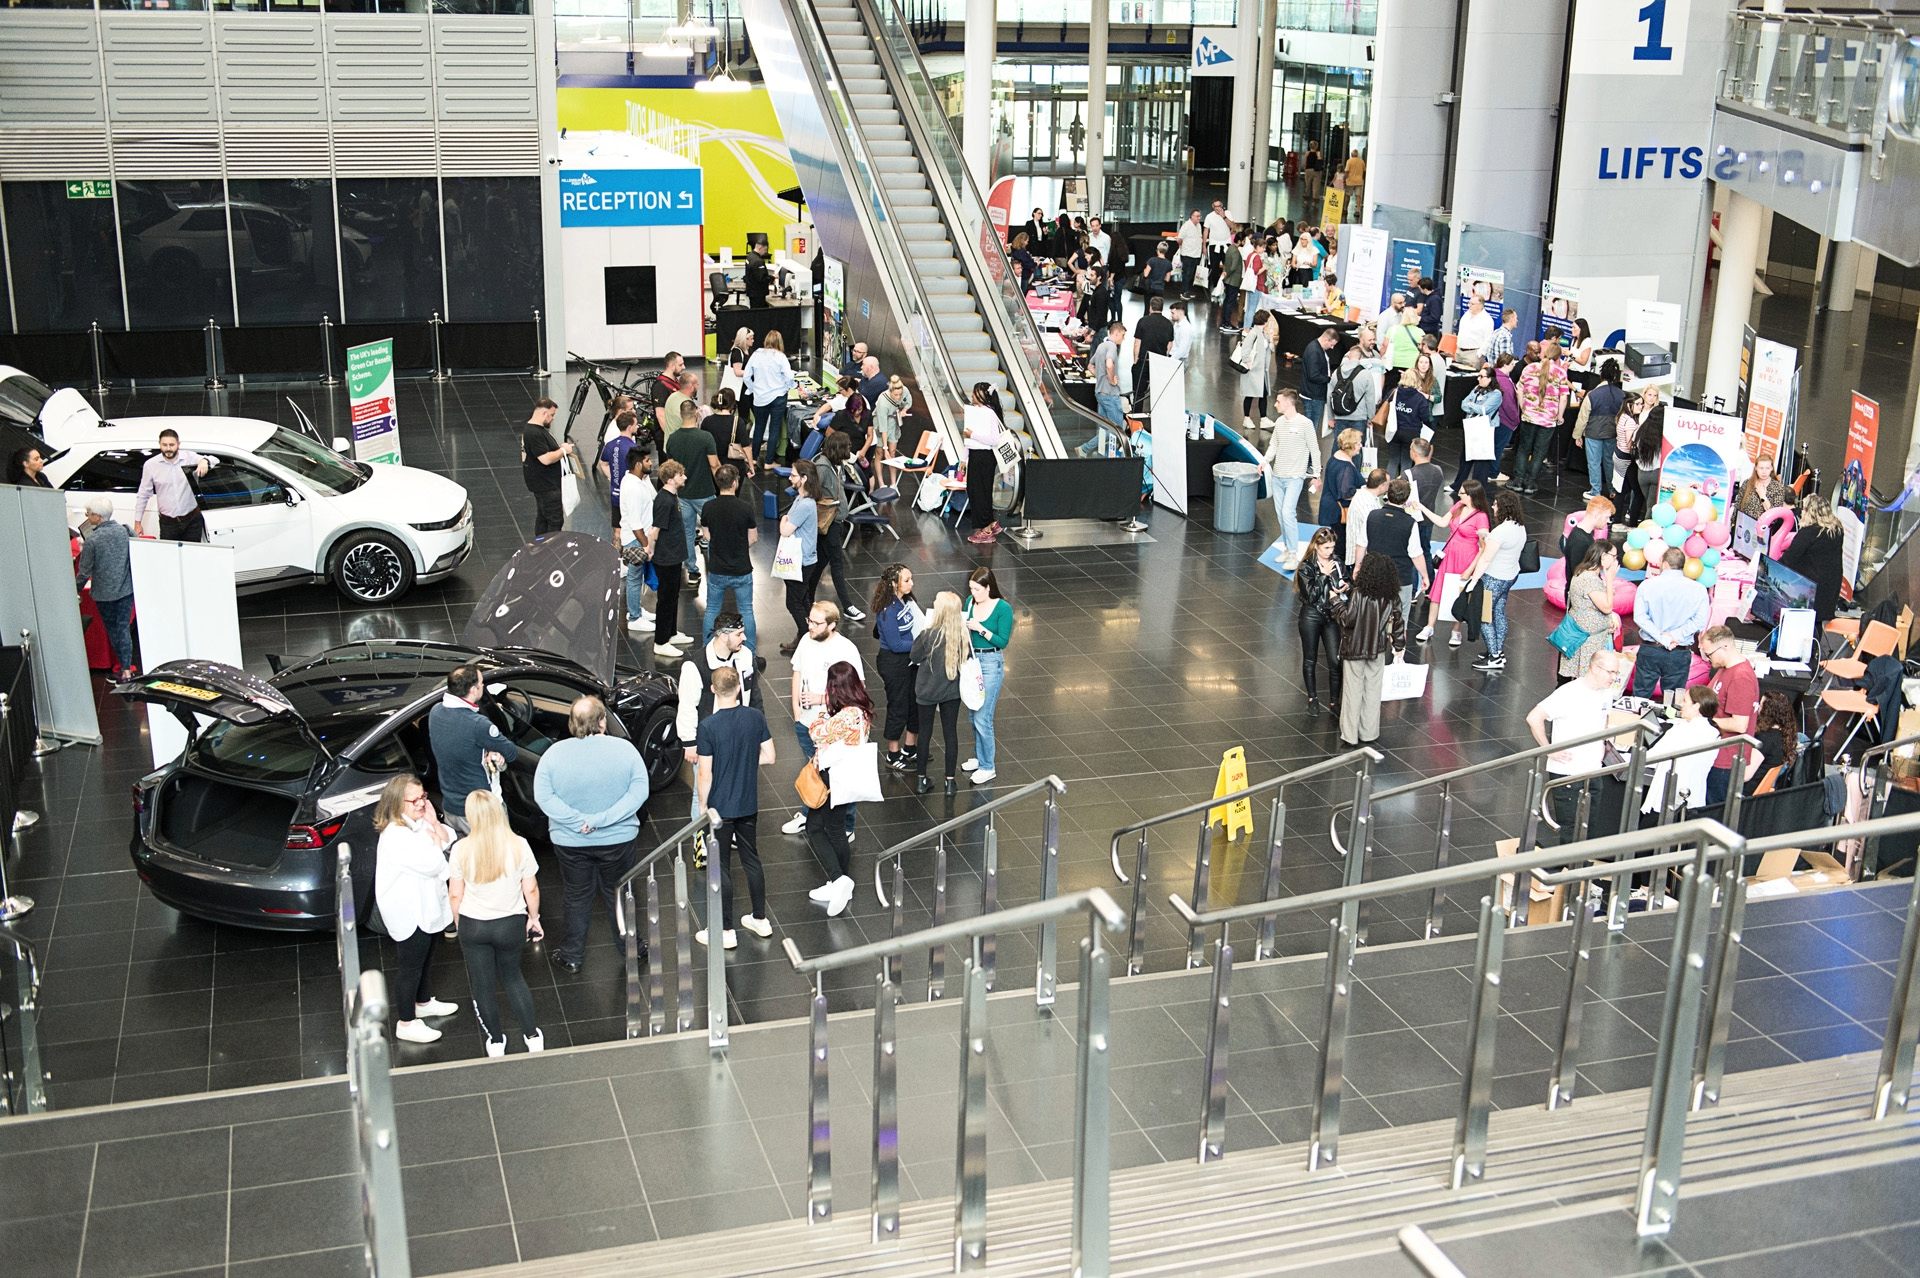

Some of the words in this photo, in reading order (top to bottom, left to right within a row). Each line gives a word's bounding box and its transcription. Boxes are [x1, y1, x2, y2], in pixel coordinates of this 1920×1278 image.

[1633, 0, 1672, 61] 1
[1597, 146, 1703, 180] LIFTS
[96, 181, 110, 189] Fire
[563, 190, 672, 211] RECEPTION
[1677, 415, 1725, 440] inspire
[1234, 806, 1246, 814] FLOOR
